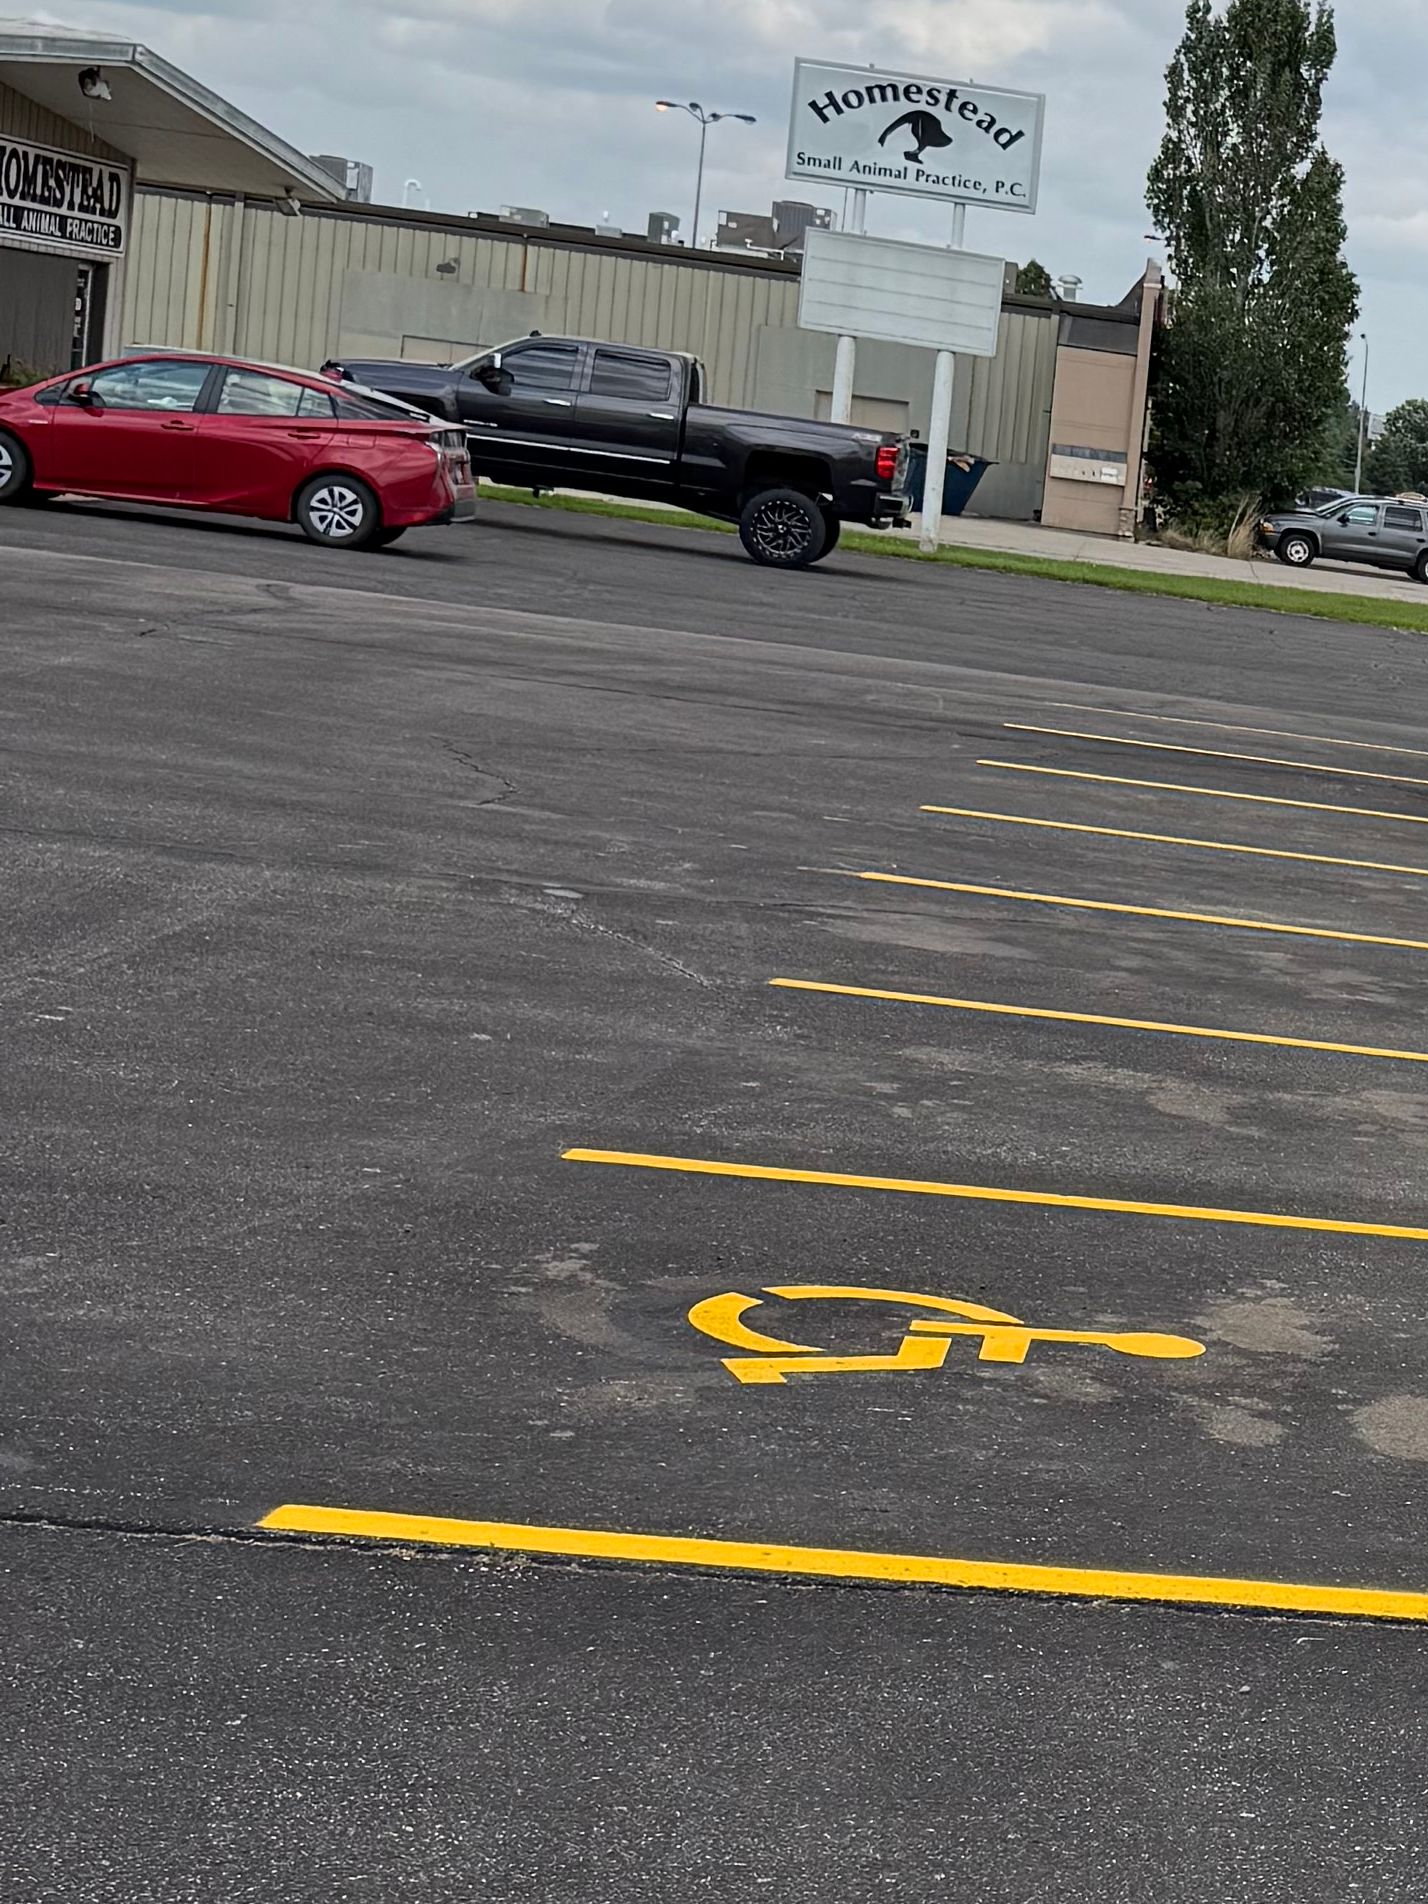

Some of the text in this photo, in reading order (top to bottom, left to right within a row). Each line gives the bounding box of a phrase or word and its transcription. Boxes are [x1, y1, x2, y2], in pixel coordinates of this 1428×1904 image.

[808, 82, 1025, 151] Homestead
[796, 151, 1027, 198] Small Animal Practice, P.C.
[21, 208, 62, 236] ANIMAL
[66, 218, 116, 246] PRACTICE
